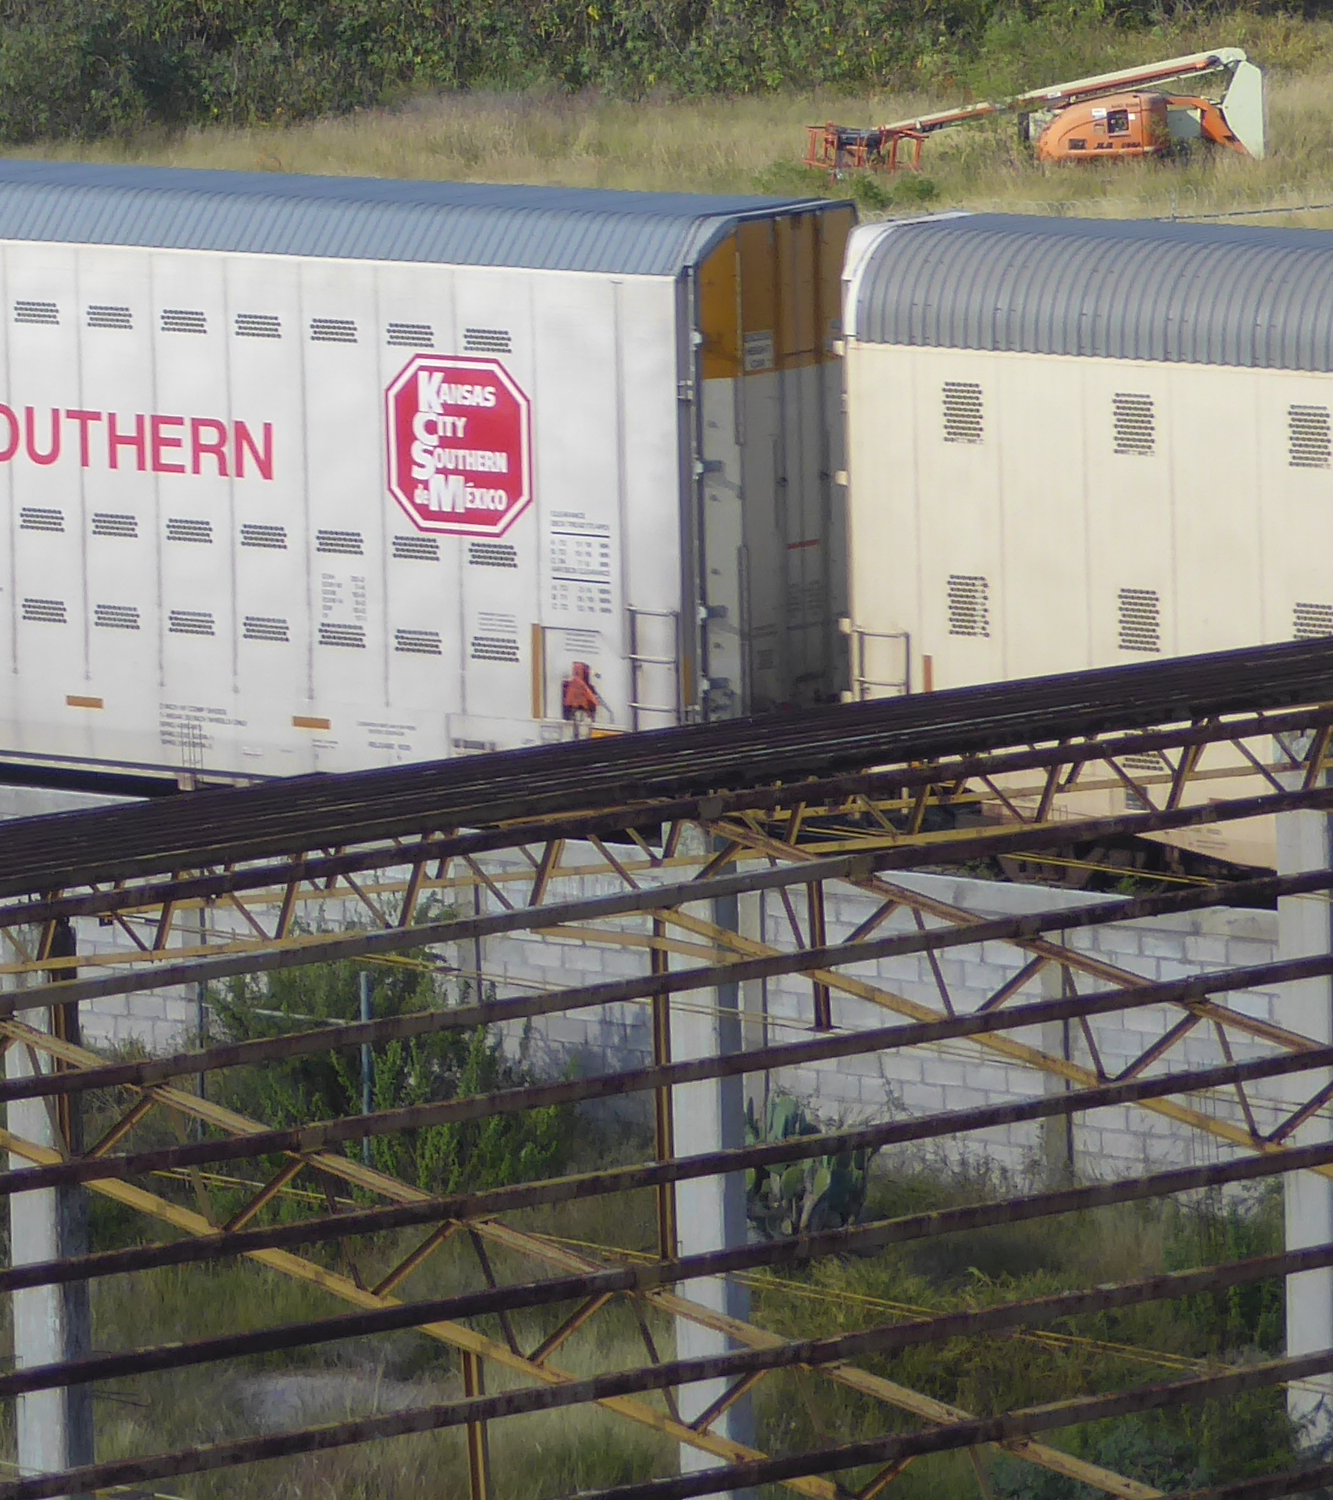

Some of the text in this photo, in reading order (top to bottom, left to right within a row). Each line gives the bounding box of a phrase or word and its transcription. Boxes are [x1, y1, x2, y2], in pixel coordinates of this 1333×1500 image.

[417, 370, 497, 413] KANSAS
[413, 411, 467, 447] CITY
[411, 439, 508, 480] SOUTHERN
